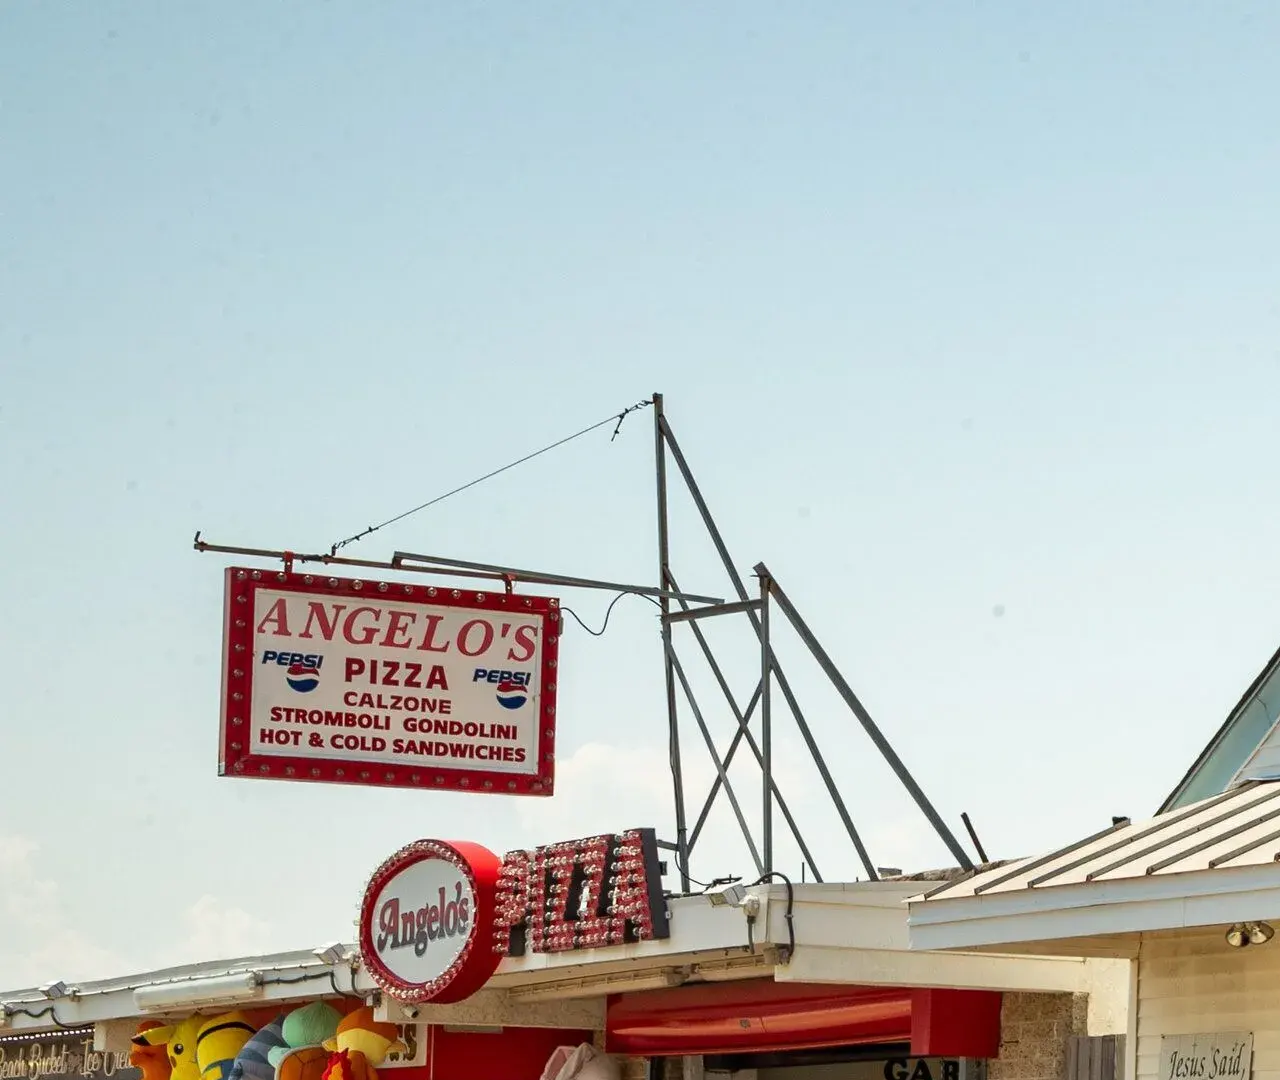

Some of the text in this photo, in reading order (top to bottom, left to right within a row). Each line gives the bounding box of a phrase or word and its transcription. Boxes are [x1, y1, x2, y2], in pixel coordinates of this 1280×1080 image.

[257, 597, 539, 663] ANGELO'S
[262, 650, 324, 671] PEPSI
[344, 657, 449, 690] PIZZA
[473, 668, 531, 687] PEPSI
[343, 691, 452, 715] CALZONE
[270, 706, 518, 740] STROMBOLI GONDOLINI
[259, 729, 527, 763] HOT & COLD SANDWICHES
[377, 880, 470, 958] Angelo's
[1208, 1043, 1246, 1080] Said,
